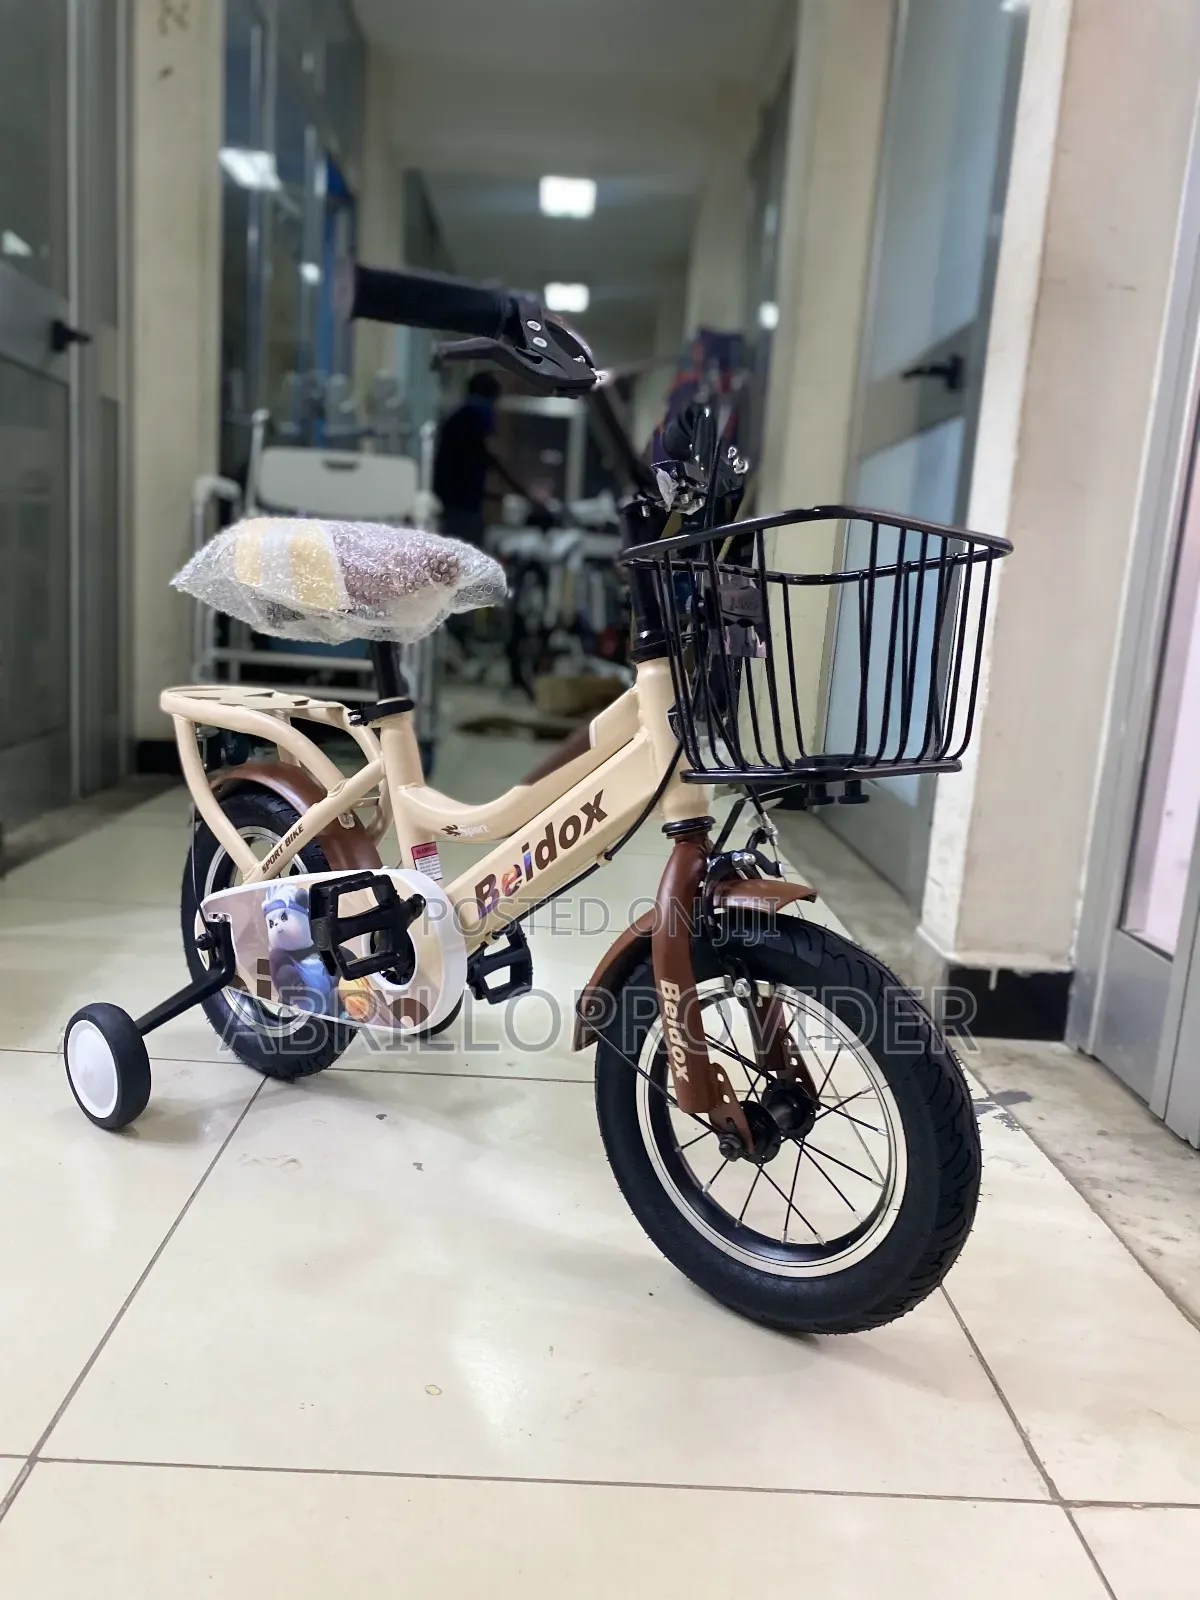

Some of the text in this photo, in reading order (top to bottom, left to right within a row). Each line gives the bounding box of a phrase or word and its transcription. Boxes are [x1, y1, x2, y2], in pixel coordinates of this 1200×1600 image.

[261, 823, 305, 874] SPORT BIKE
[474, 788, 608, 921] Beidox
[660, 979, 690, 1083] Beidox
